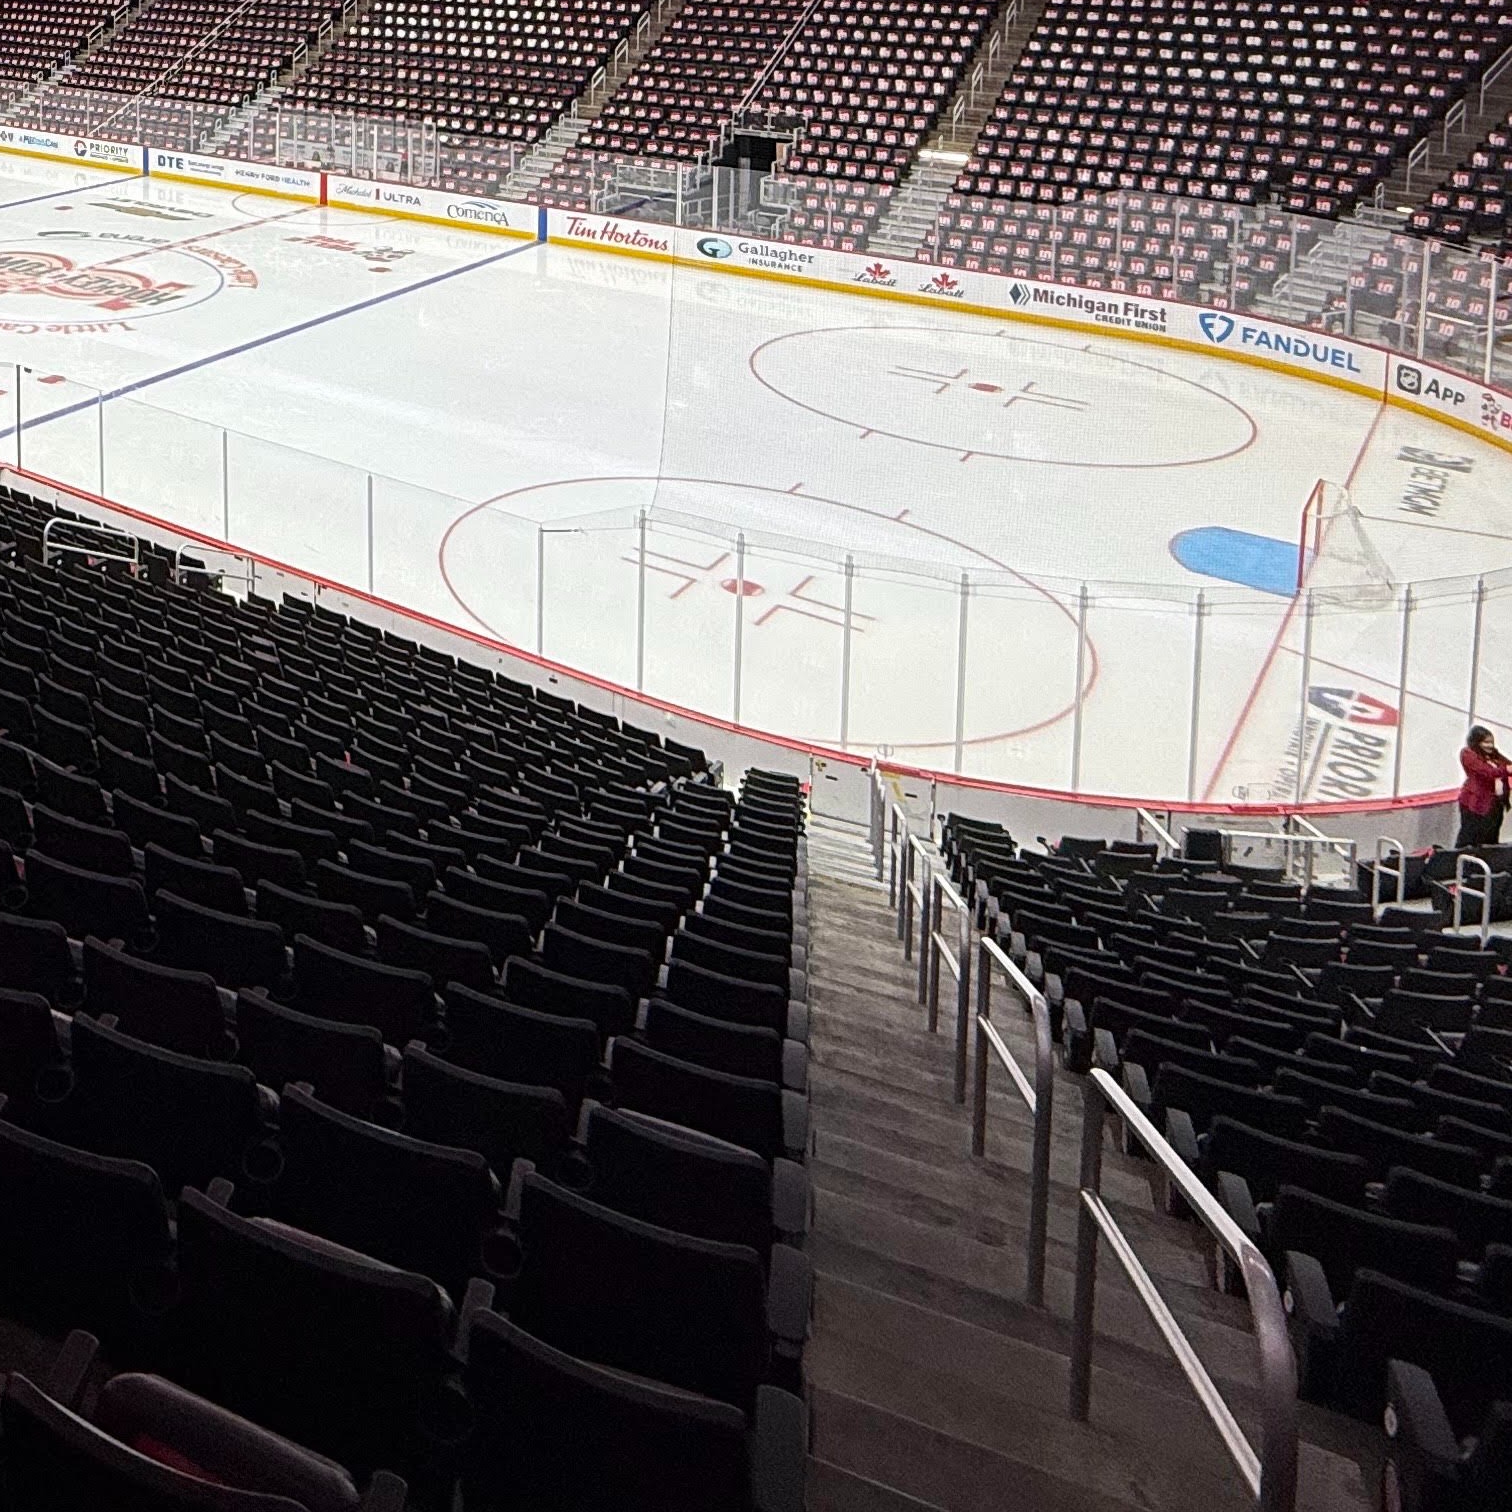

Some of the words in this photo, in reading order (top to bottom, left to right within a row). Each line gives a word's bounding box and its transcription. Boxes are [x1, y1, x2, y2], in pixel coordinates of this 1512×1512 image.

[90, 142, 128, 156] PRIORITY
[158, 155, 183, 170] DTE
[383, 191, 422, 206] ULTRA
[566, 217, 598, 239] Tim
[599, 221, 668, 251] Hortons
[738, 242, 815, 264] Gallagher
[749, 257, 803, 272] INSURANCE
[853, 273, 897, 288] Labatt
[918, 282, 964, 299] Labatt
[1033, 287, 1119, 314] Michigan
[1123, 302, 1167, 323] First
[47, 323, 139, 335] Little
[1095, 313, 1132, 326] CREDIT
[1134, 320, 1166, 332] UNION
[1242, 327, 1361, 374] FANDUEL
